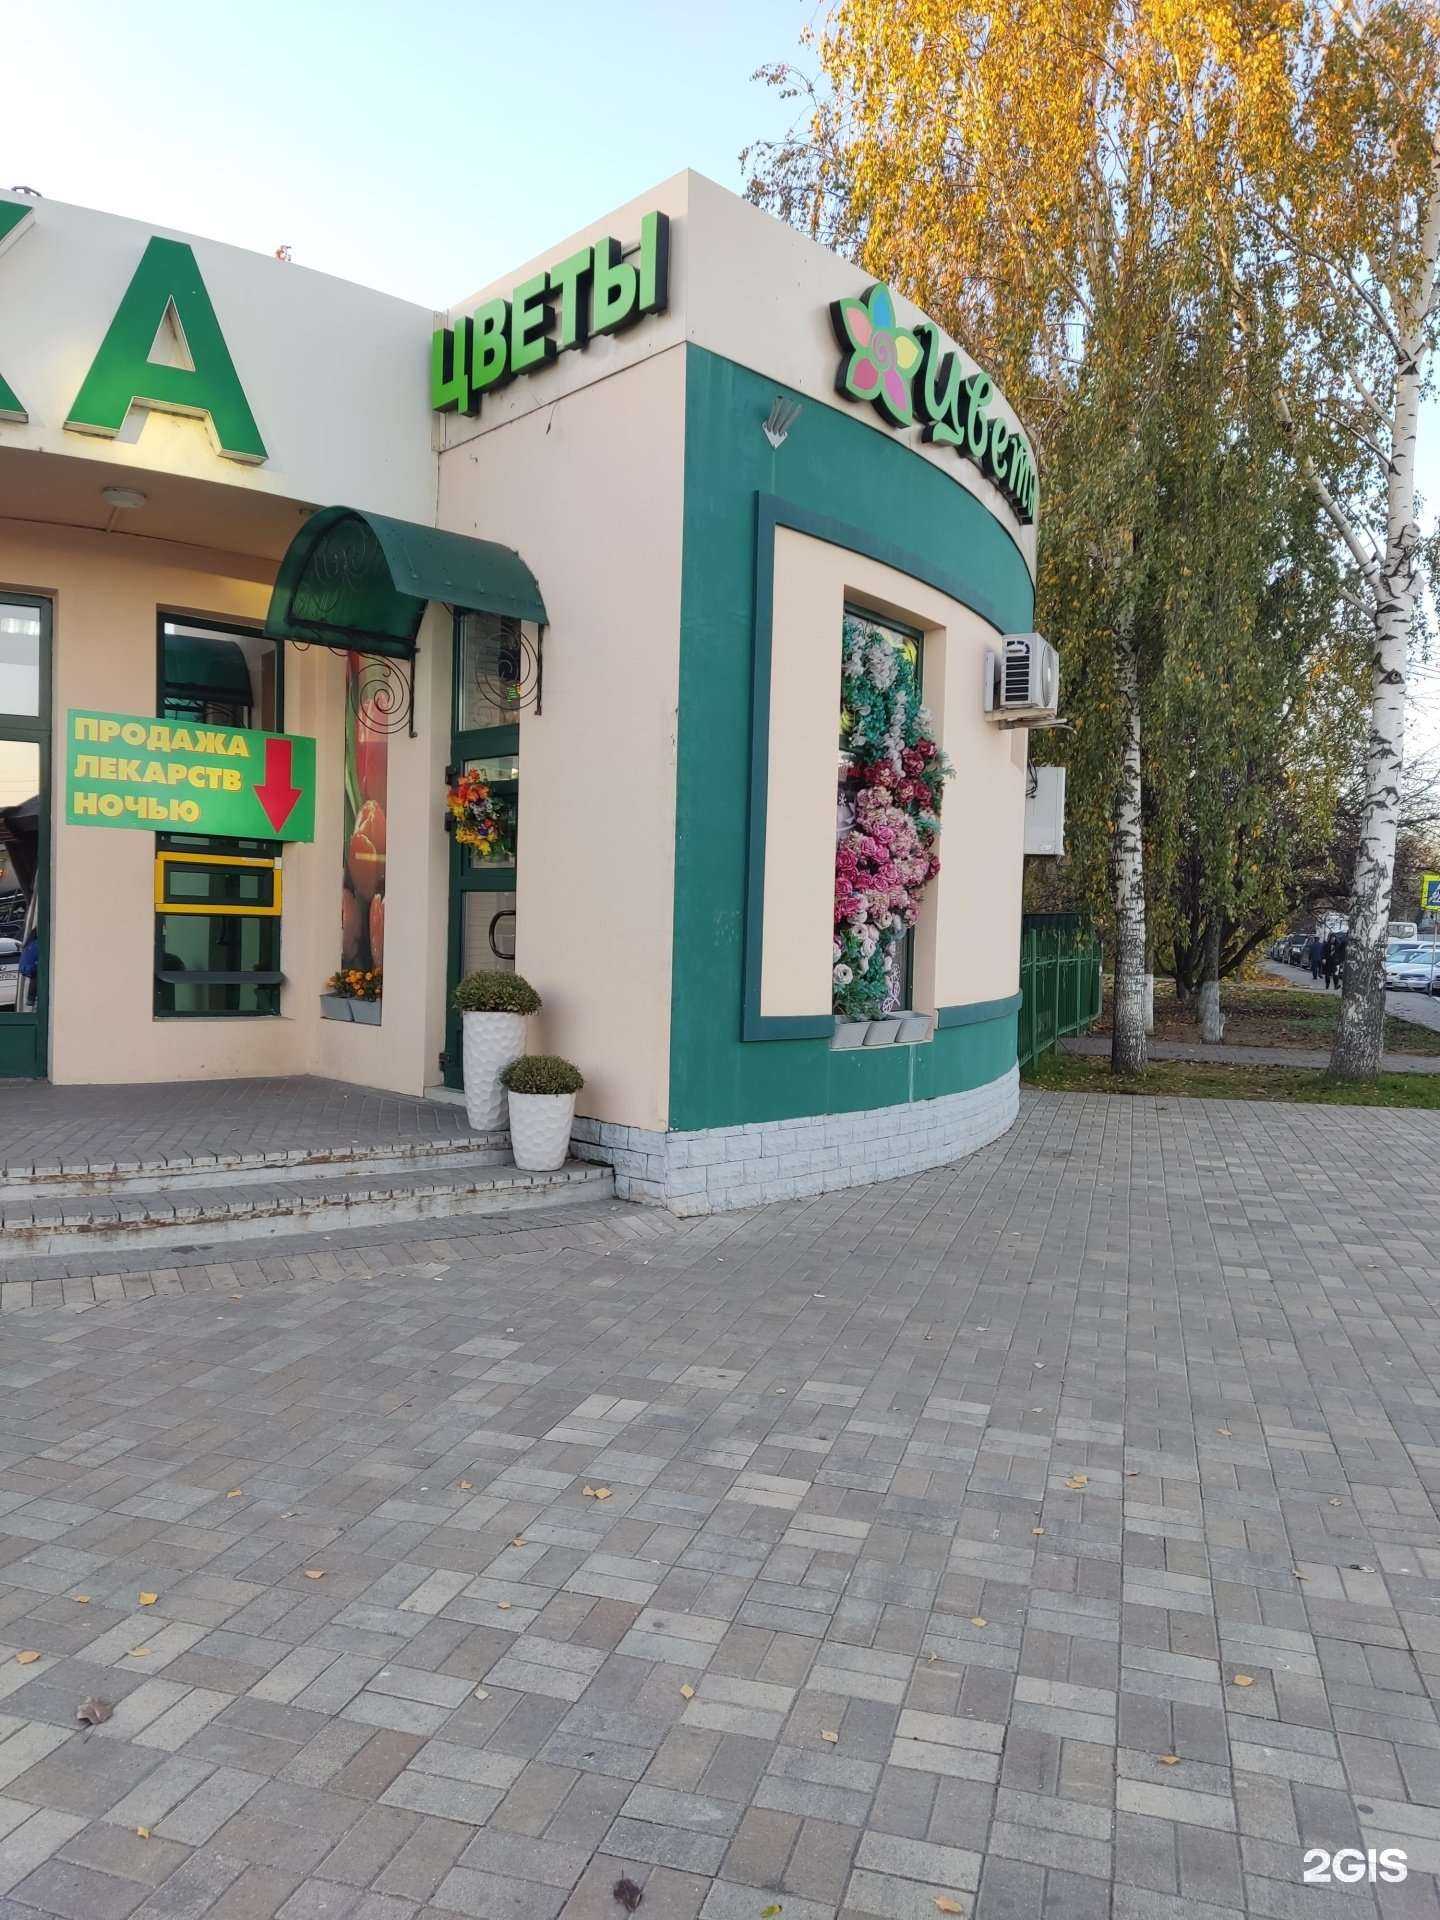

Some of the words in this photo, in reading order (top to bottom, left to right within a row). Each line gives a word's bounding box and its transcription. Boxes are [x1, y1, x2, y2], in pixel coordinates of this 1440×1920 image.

[432, 211, 668, 416] ЦВЕТЫ
[74, 717, 249, 757] ПРОДАЖА
[74, 755, 242, 791] ЛЕКАРСТВ
[73, 792, 200, 822] НОЧЬЮ
